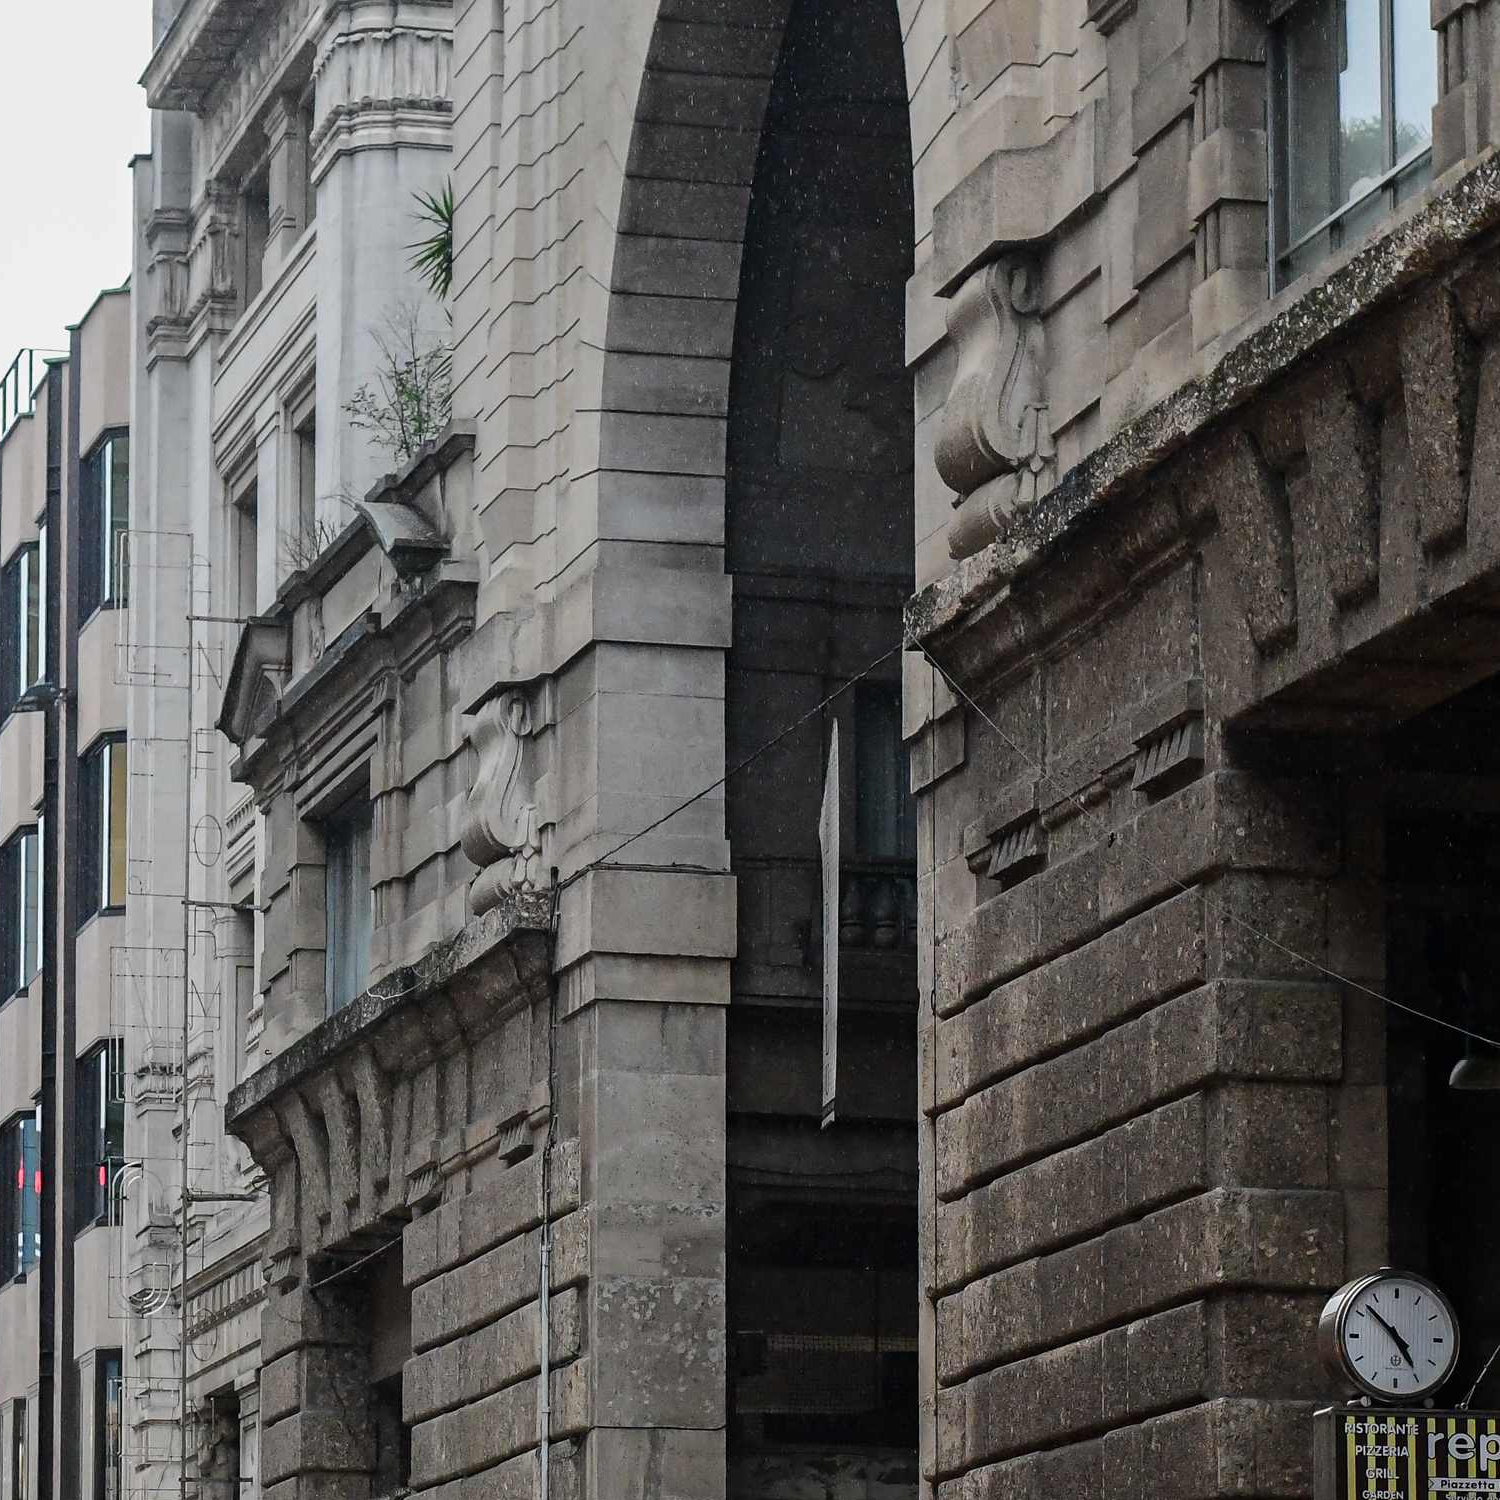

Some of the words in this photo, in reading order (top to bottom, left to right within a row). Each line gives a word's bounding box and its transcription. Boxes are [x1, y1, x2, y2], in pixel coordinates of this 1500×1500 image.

[1344, 1422, 1419, 1435] RISTORANTE
[1355, 1445, 1409, 1457] PIZZERIA
[1365, 1468, 1400, 1480] GRILL
[1440, 1479, 1495, 1490] Piazzetta
[1362, 1490, 1404, 1500] GARDEN
